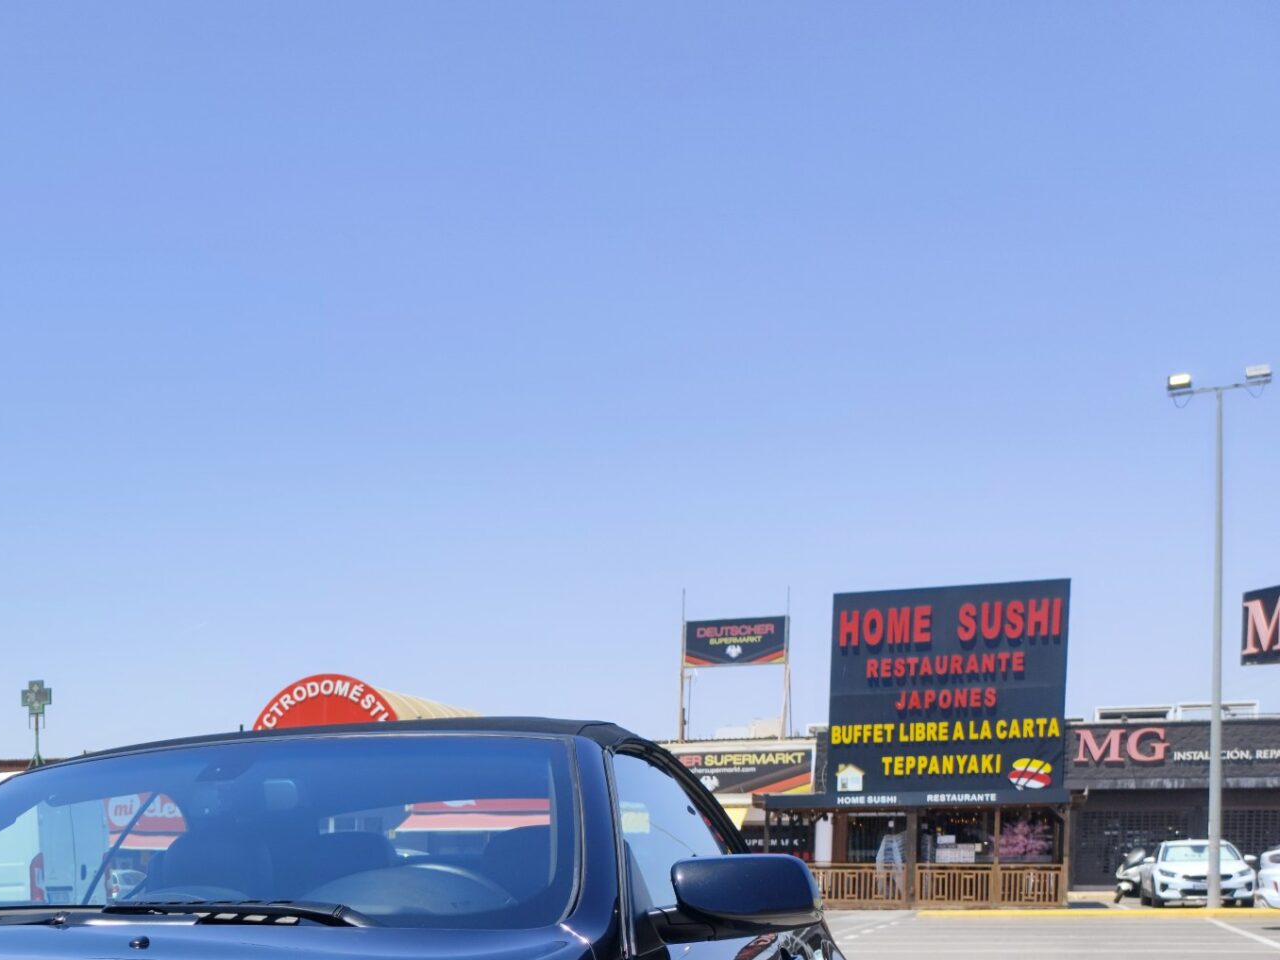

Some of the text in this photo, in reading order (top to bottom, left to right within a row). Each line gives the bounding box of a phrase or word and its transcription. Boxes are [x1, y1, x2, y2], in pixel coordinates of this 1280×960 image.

[696, 623, 775, 638] DEUTSCHER
[838, 597, 1062, 647] HOME SUSHI
[709, 635, 762, 645] SUPERMARKT
[866, 651, 1025, 678] RESTAURANTE
[895, 687, 997, 710] JAPONES
[831, 717, 1060, 745] BUFFET LIBRE A LA CARTA
[1074, 727, 1170, 763] MG
[704, 752, 806, 766] SUPERMARKT
[882, 754, 1002, 776] TEPPANYAKI
[837, 793, 997, 804] HOME SUSHI RESTAURANTE
